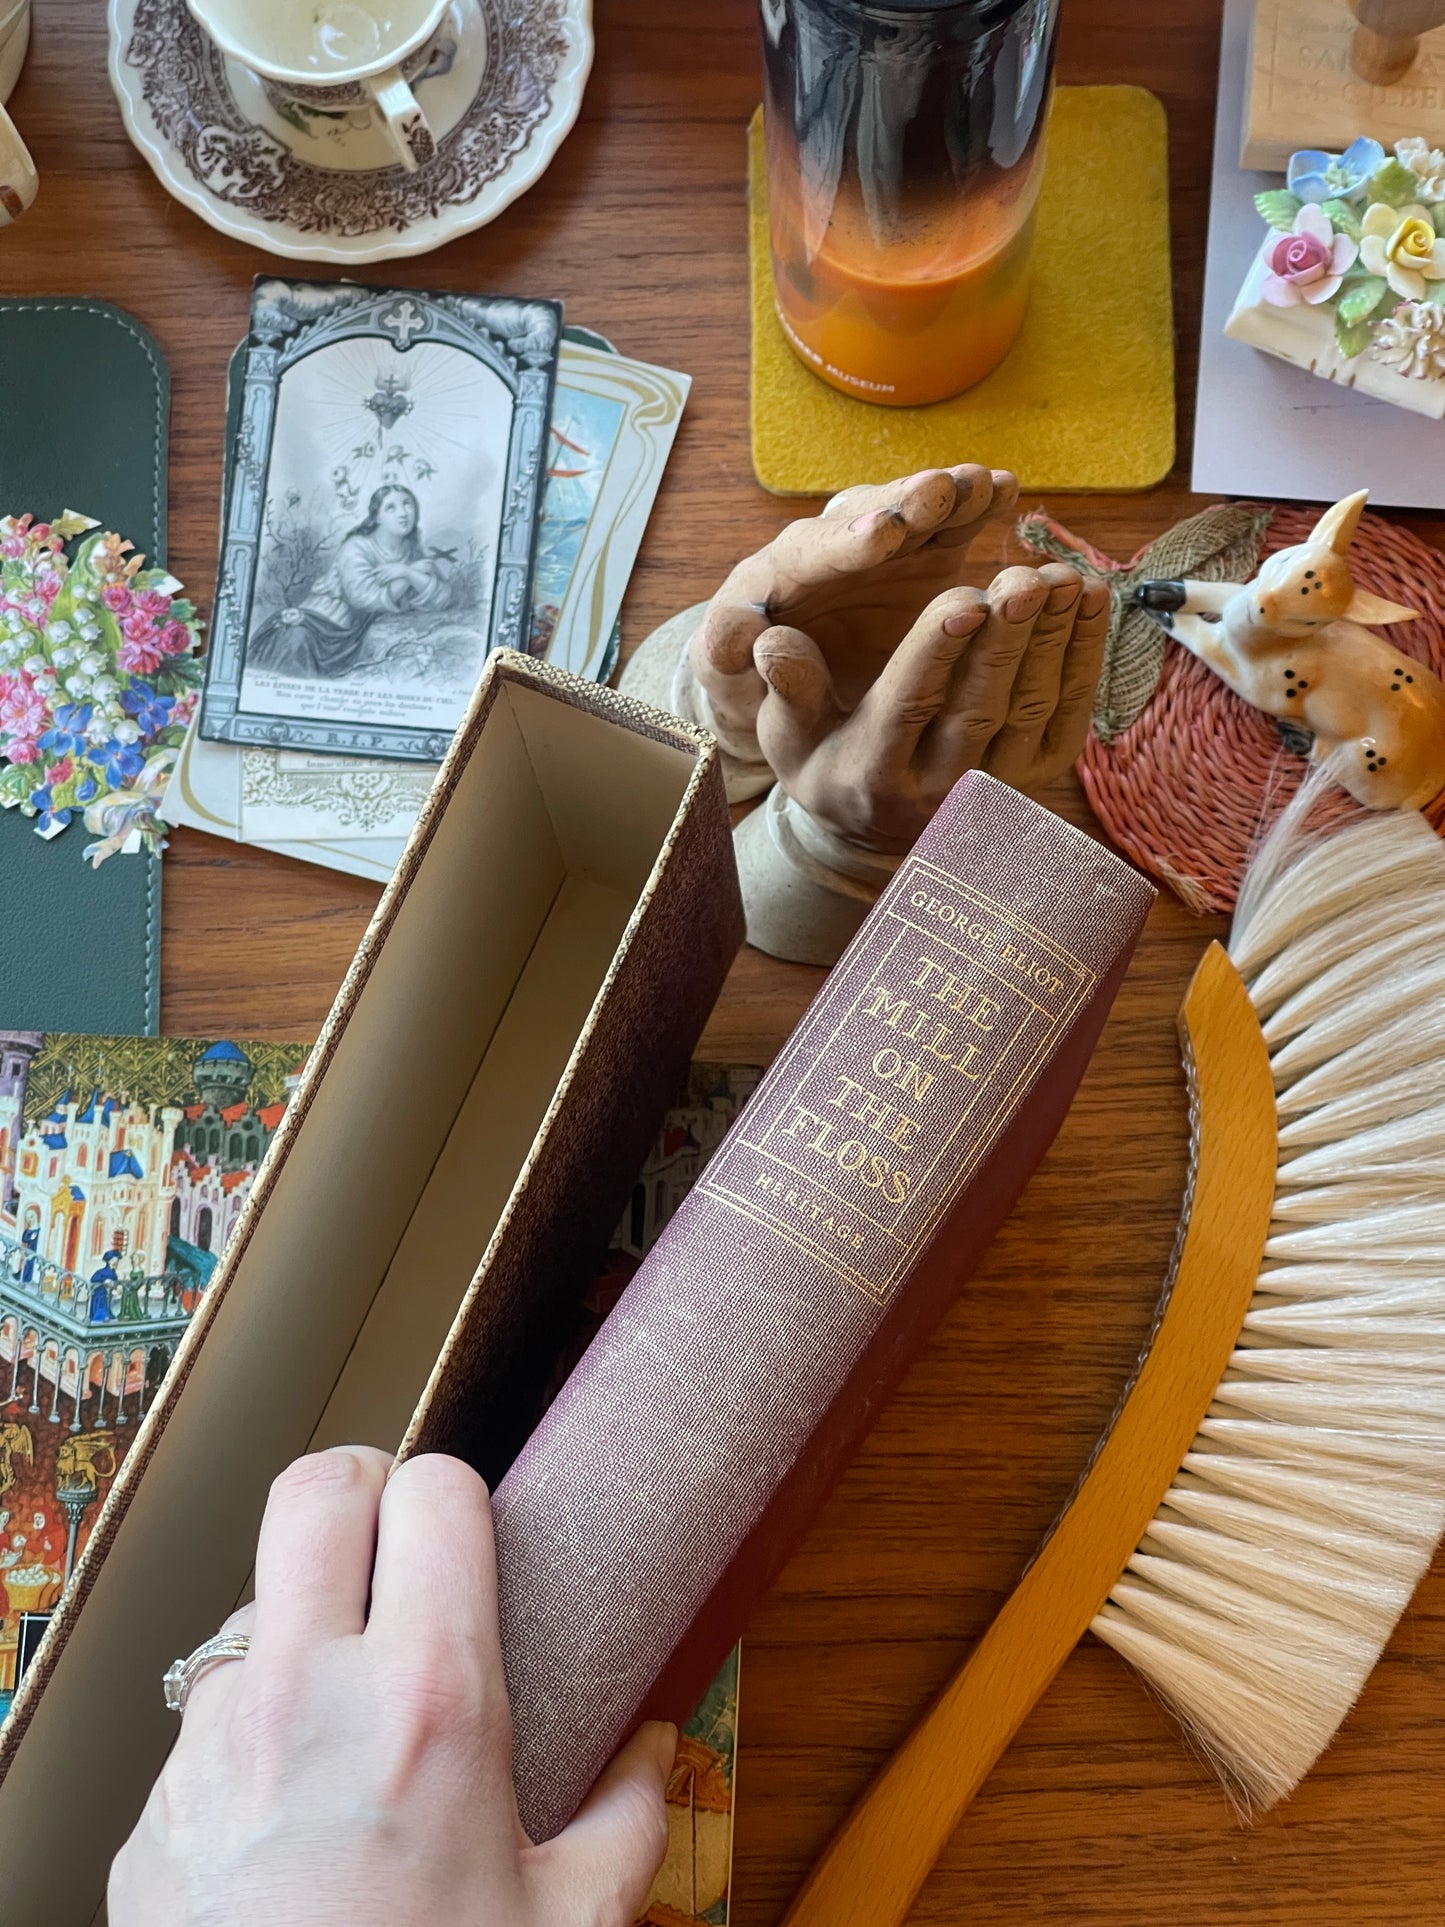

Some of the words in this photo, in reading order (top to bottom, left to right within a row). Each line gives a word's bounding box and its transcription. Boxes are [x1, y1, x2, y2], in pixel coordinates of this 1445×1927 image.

[825, 363, 895, 393] MUSEUM
[255, 680, 270, 689] LES
[378, 691, 393, 699] LES
[326, 732, 387, 748] R.I.P.
[909, 890, 996, 949] GEORGE
[1001, 941, 1066, 996] ELIOT
[909, 955, 1002, 1032] THE
[862, 986, 981, 1081] MILL
[827, 1074, 921, 1152] THE
[872, 1047, 936, 1104] ON
[782, 1105, 911, 1205] FLOSS
[755, 1171, 864, 1250] HERITAGE
